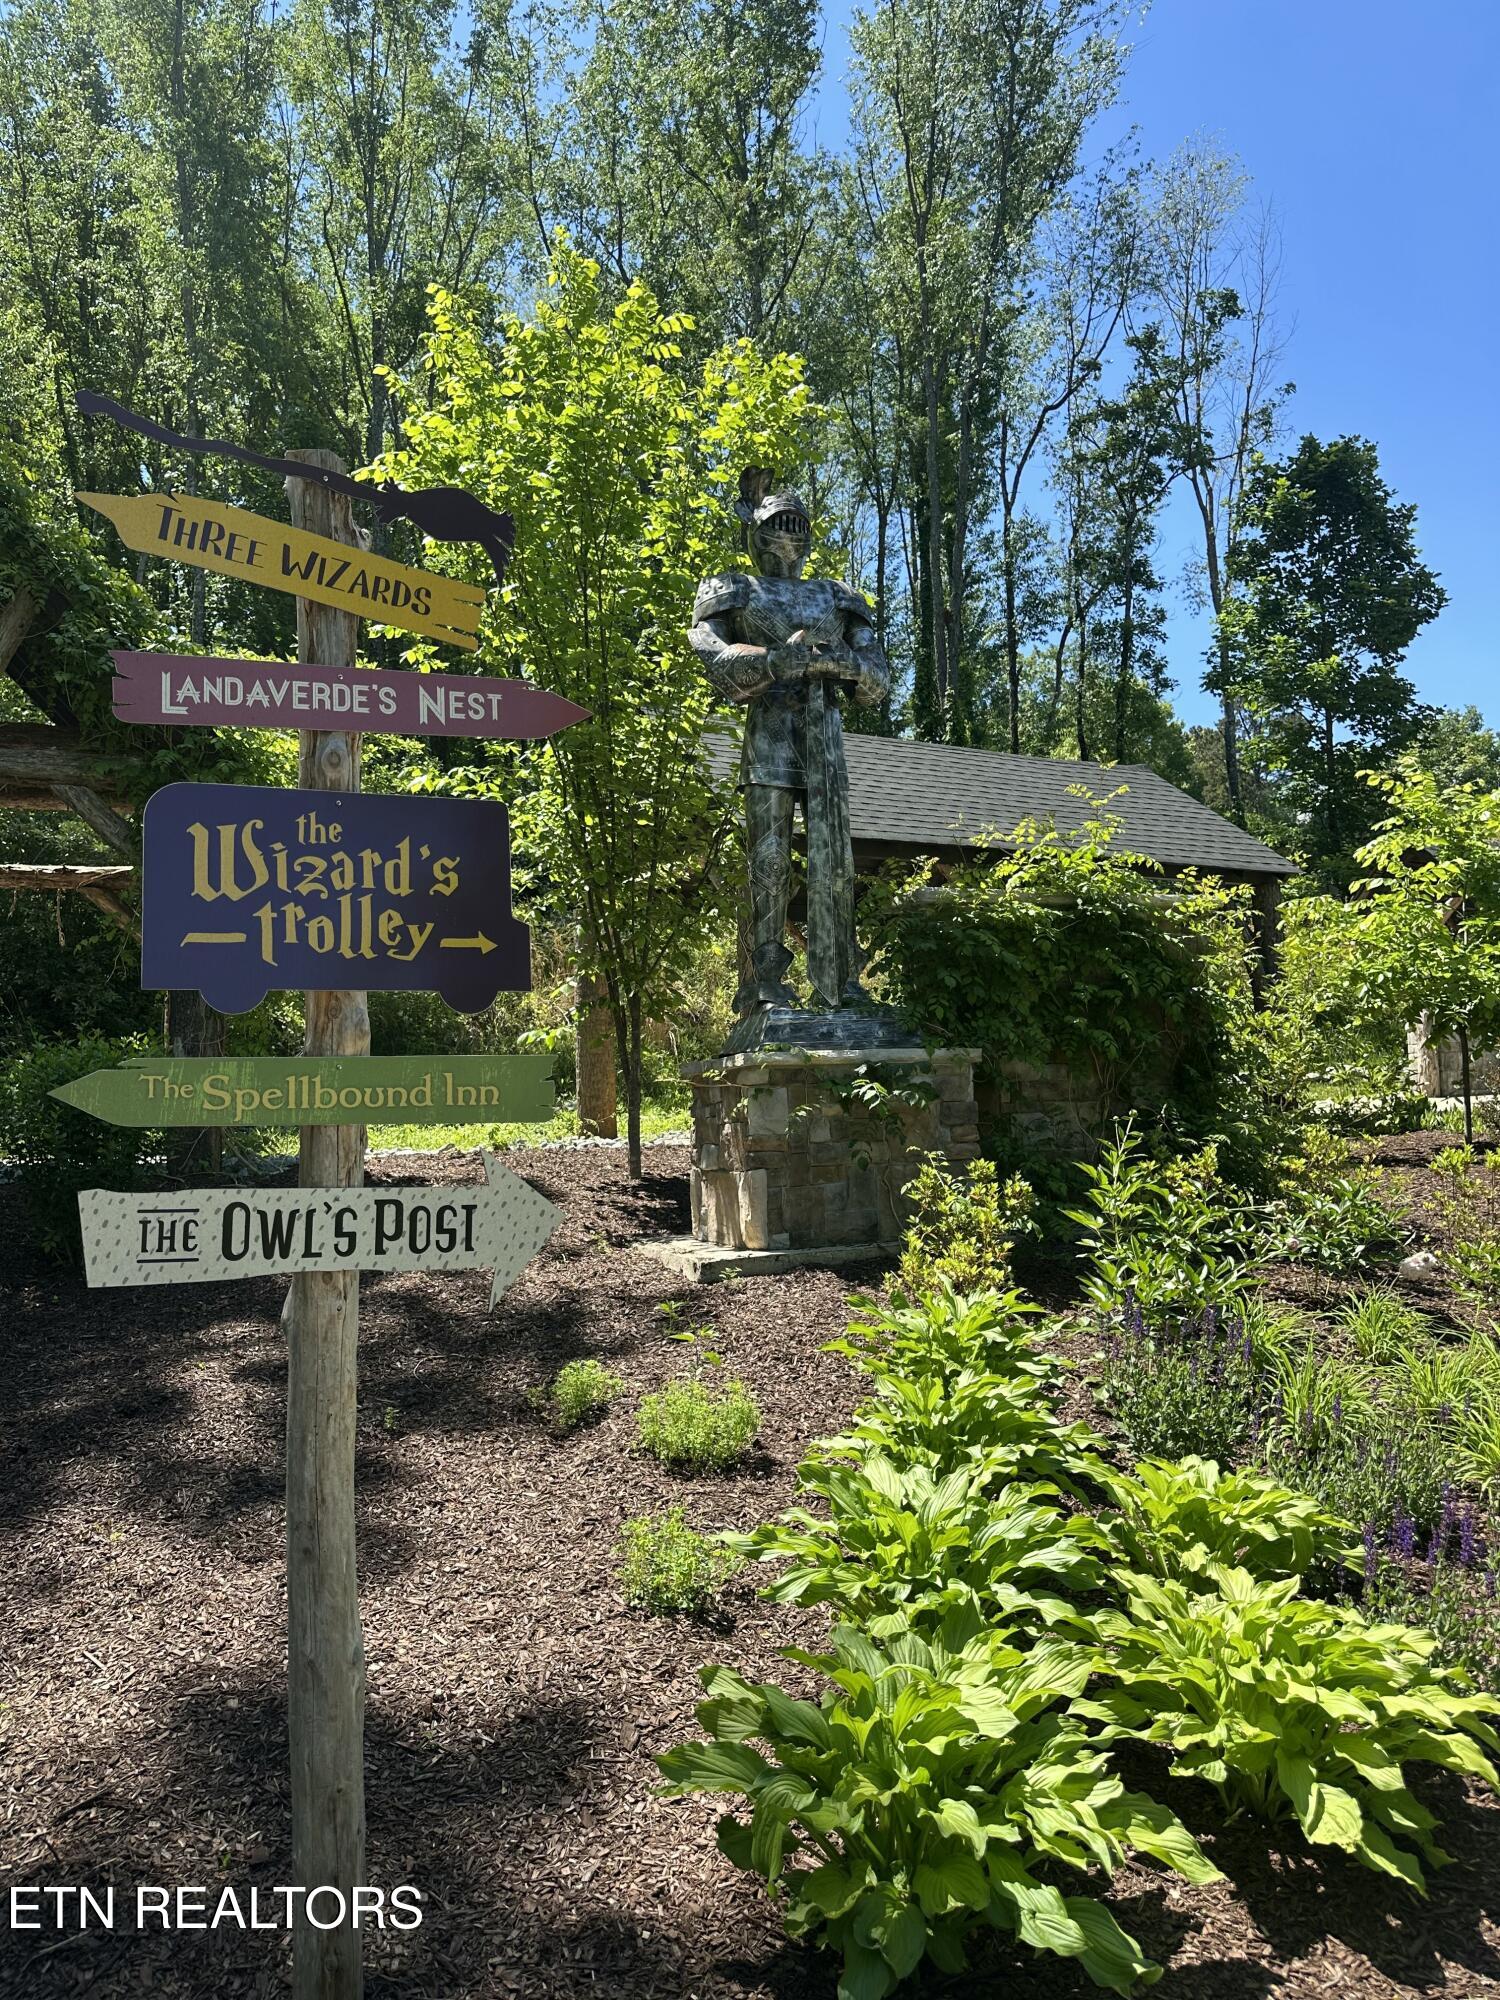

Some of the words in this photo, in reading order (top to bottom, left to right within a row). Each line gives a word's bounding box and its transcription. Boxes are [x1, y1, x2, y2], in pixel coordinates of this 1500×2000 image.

[156, 504, 267, 568] THREE
[281, 543, 432, 616] WIZARDS
[419, 685, 503, 727] NEST
[296, 811, 344, 845] the
[186, 819, 461, 902] Wizard's
[252, 893, 435, 967] trolley
[138, 1074, 194, 1099] The
[202, 1073, 435, 1122] Spellbound
[444, 1072, 500, 1107] Inn
[138, 1218, 200, 1254] THE
[221, 1201, 358, 1262] OWL'S
[374, 1199, 478, 1256] POST
